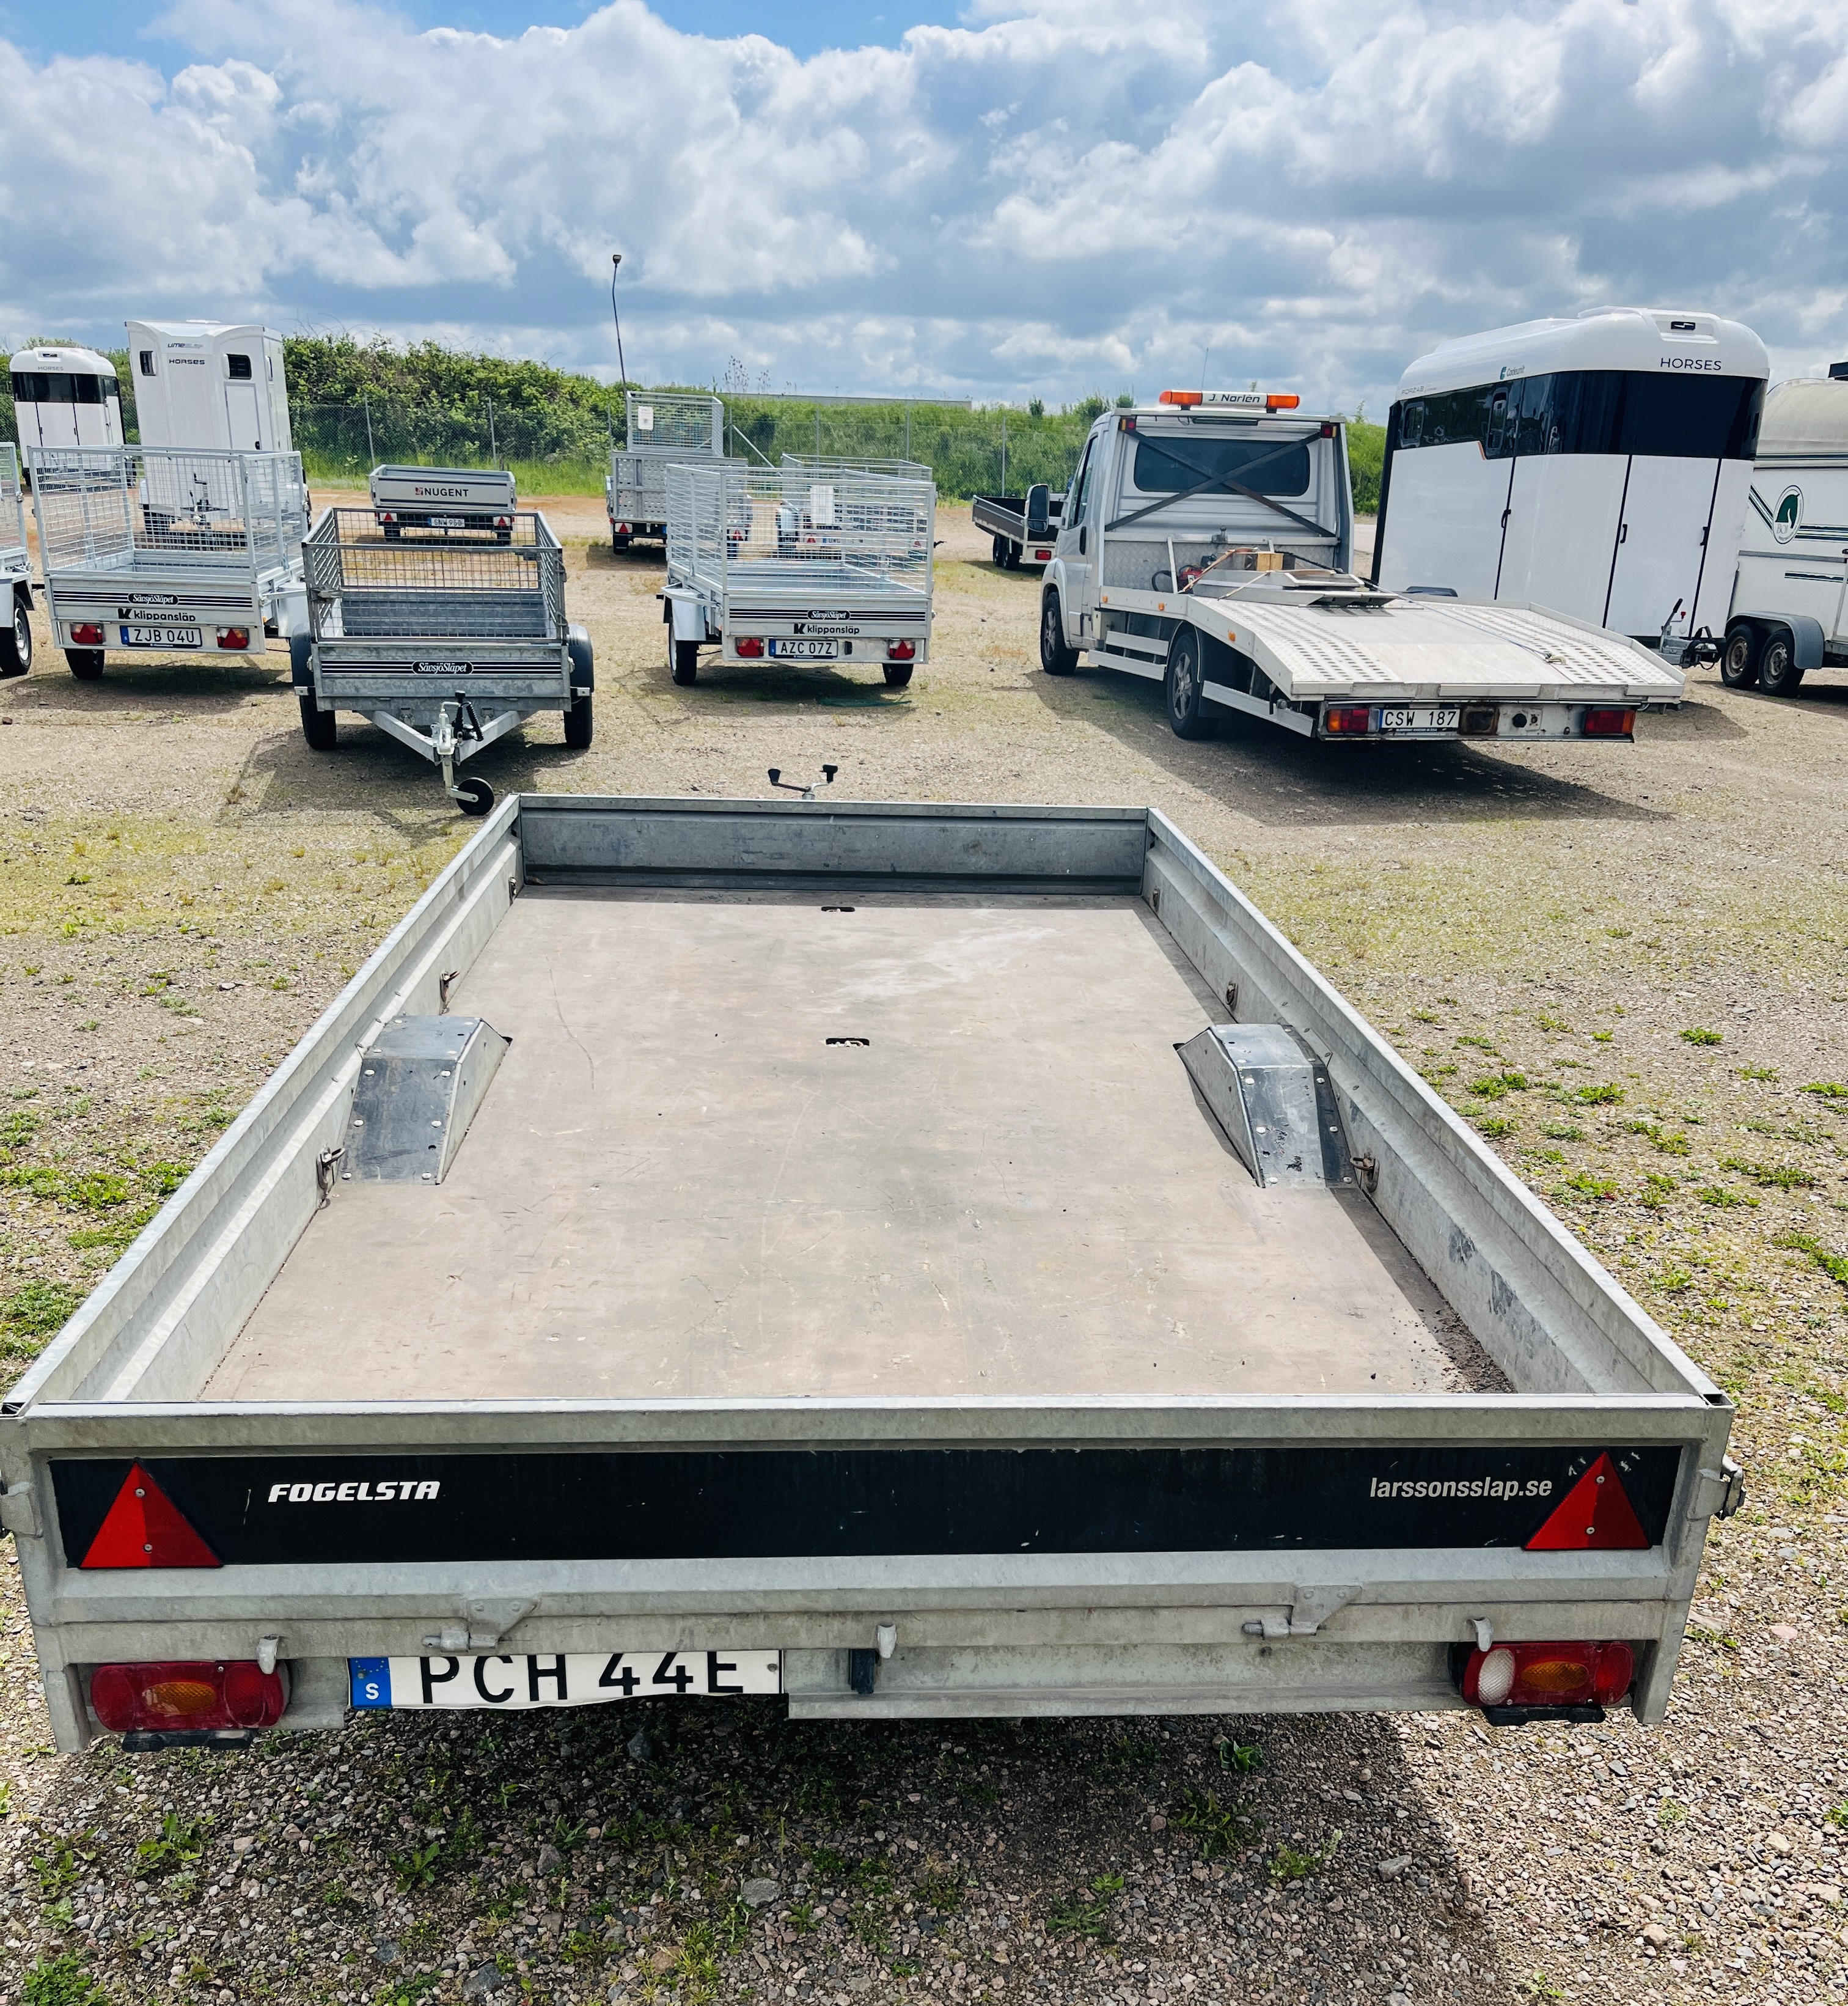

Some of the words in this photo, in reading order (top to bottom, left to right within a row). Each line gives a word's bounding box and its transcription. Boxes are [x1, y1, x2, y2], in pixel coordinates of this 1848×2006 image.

[1660, 358, 1722, 370] HORSES
[424, 488, 469, 497] NUGENT
[133, 593, 174, 604] SävsjöSläpet
[134, 610, 196, 622] klippansläp
[807, 625, 860, 634] klippansläp
[134, 629, 162, 642] ZJB
[167, 630, 194, 643] 04U
[780, 642, 804, 653] AZC
[809, 642, 832, 654] 07Z
[418, 662, 467, 674] SävsjöSläpet
[1385, 711, 1415, 726] CSW
[1429, 711, 1456, 726] 187
[268, 1481, 441, 1502] FOGELSTA
[1370, 1477, 1552, 1501] larssonsslap.se
[420, 1655, 568, 1703] PCH
[599, 1651, 744, 1696] 44E
